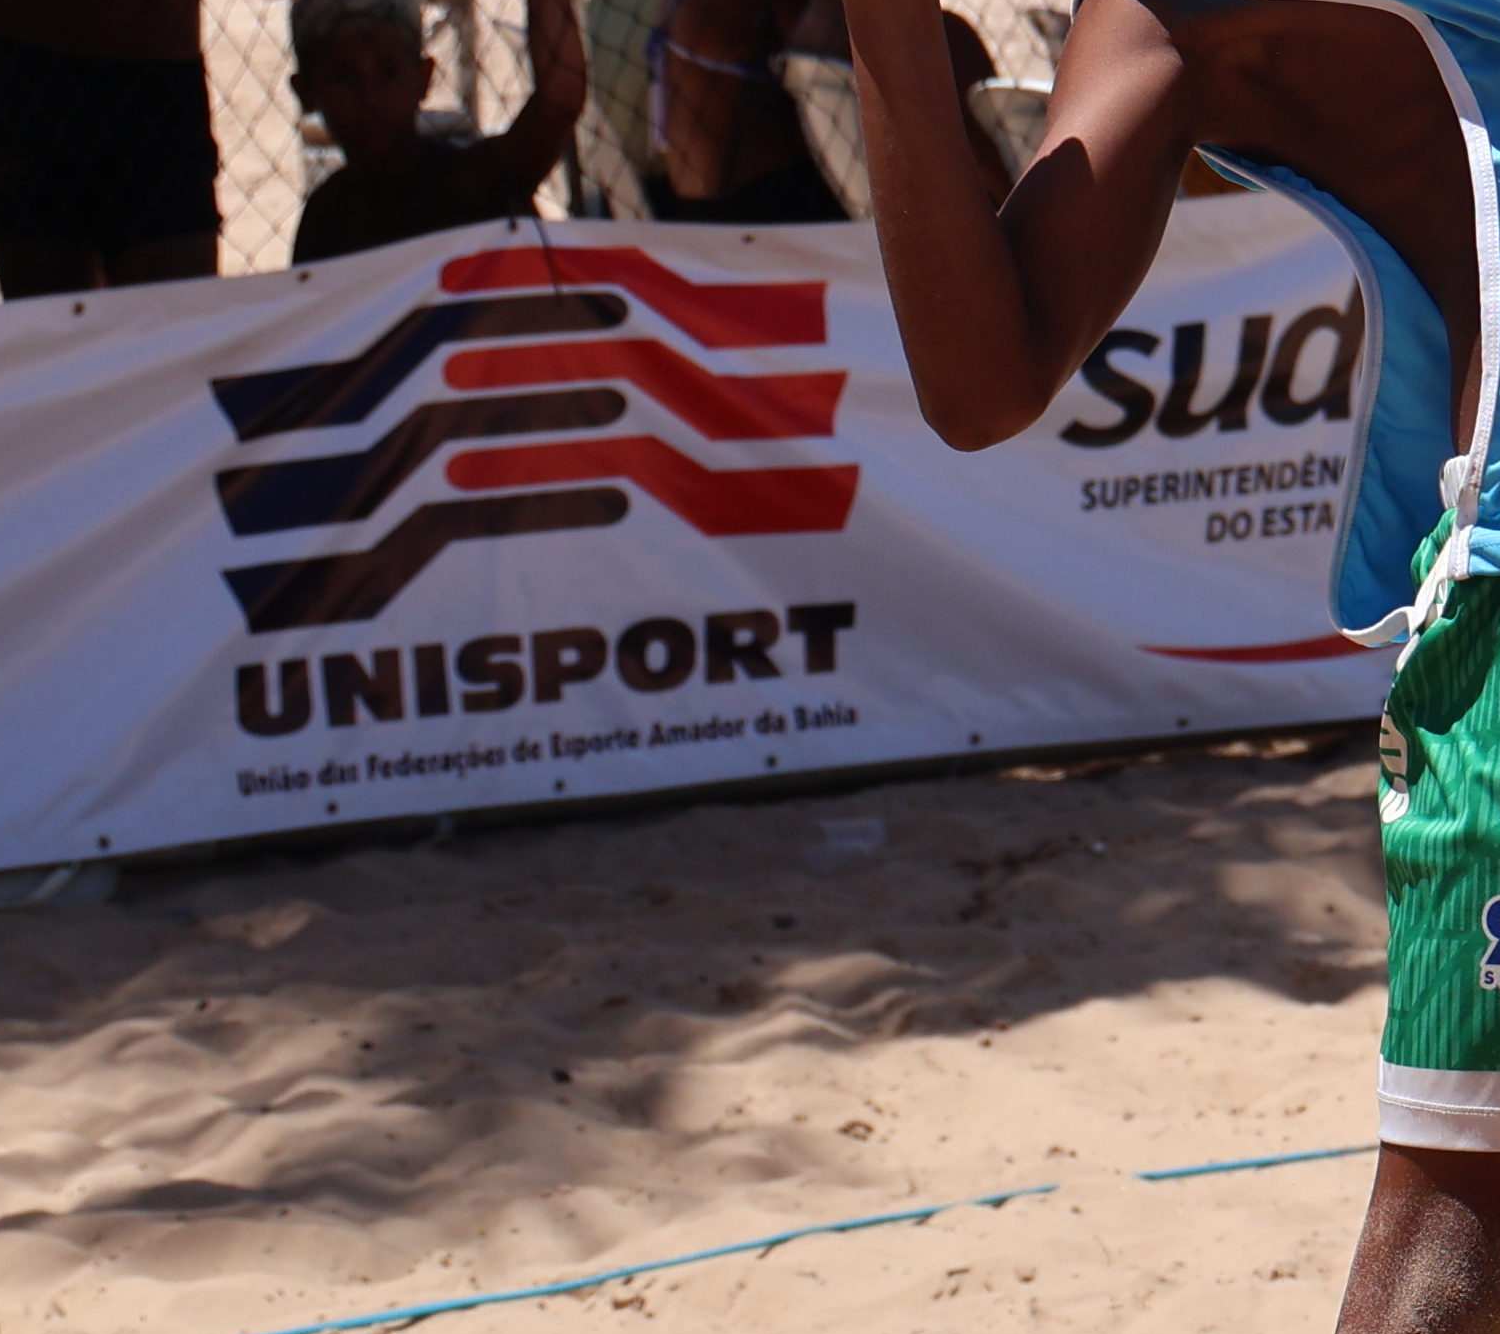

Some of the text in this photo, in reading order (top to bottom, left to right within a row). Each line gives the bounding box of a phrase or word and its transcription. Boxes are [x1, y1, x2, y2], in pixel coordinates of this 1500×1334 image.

[1081, 453, 1347, 512] SUPERINTENDÊN
[1205, 503, 1336, 544] DO ESTA
[234, 603, 856, 738] UNISPORT
[237, 701, 858, 797] União das Federações de Esporte Amador da Bahia
